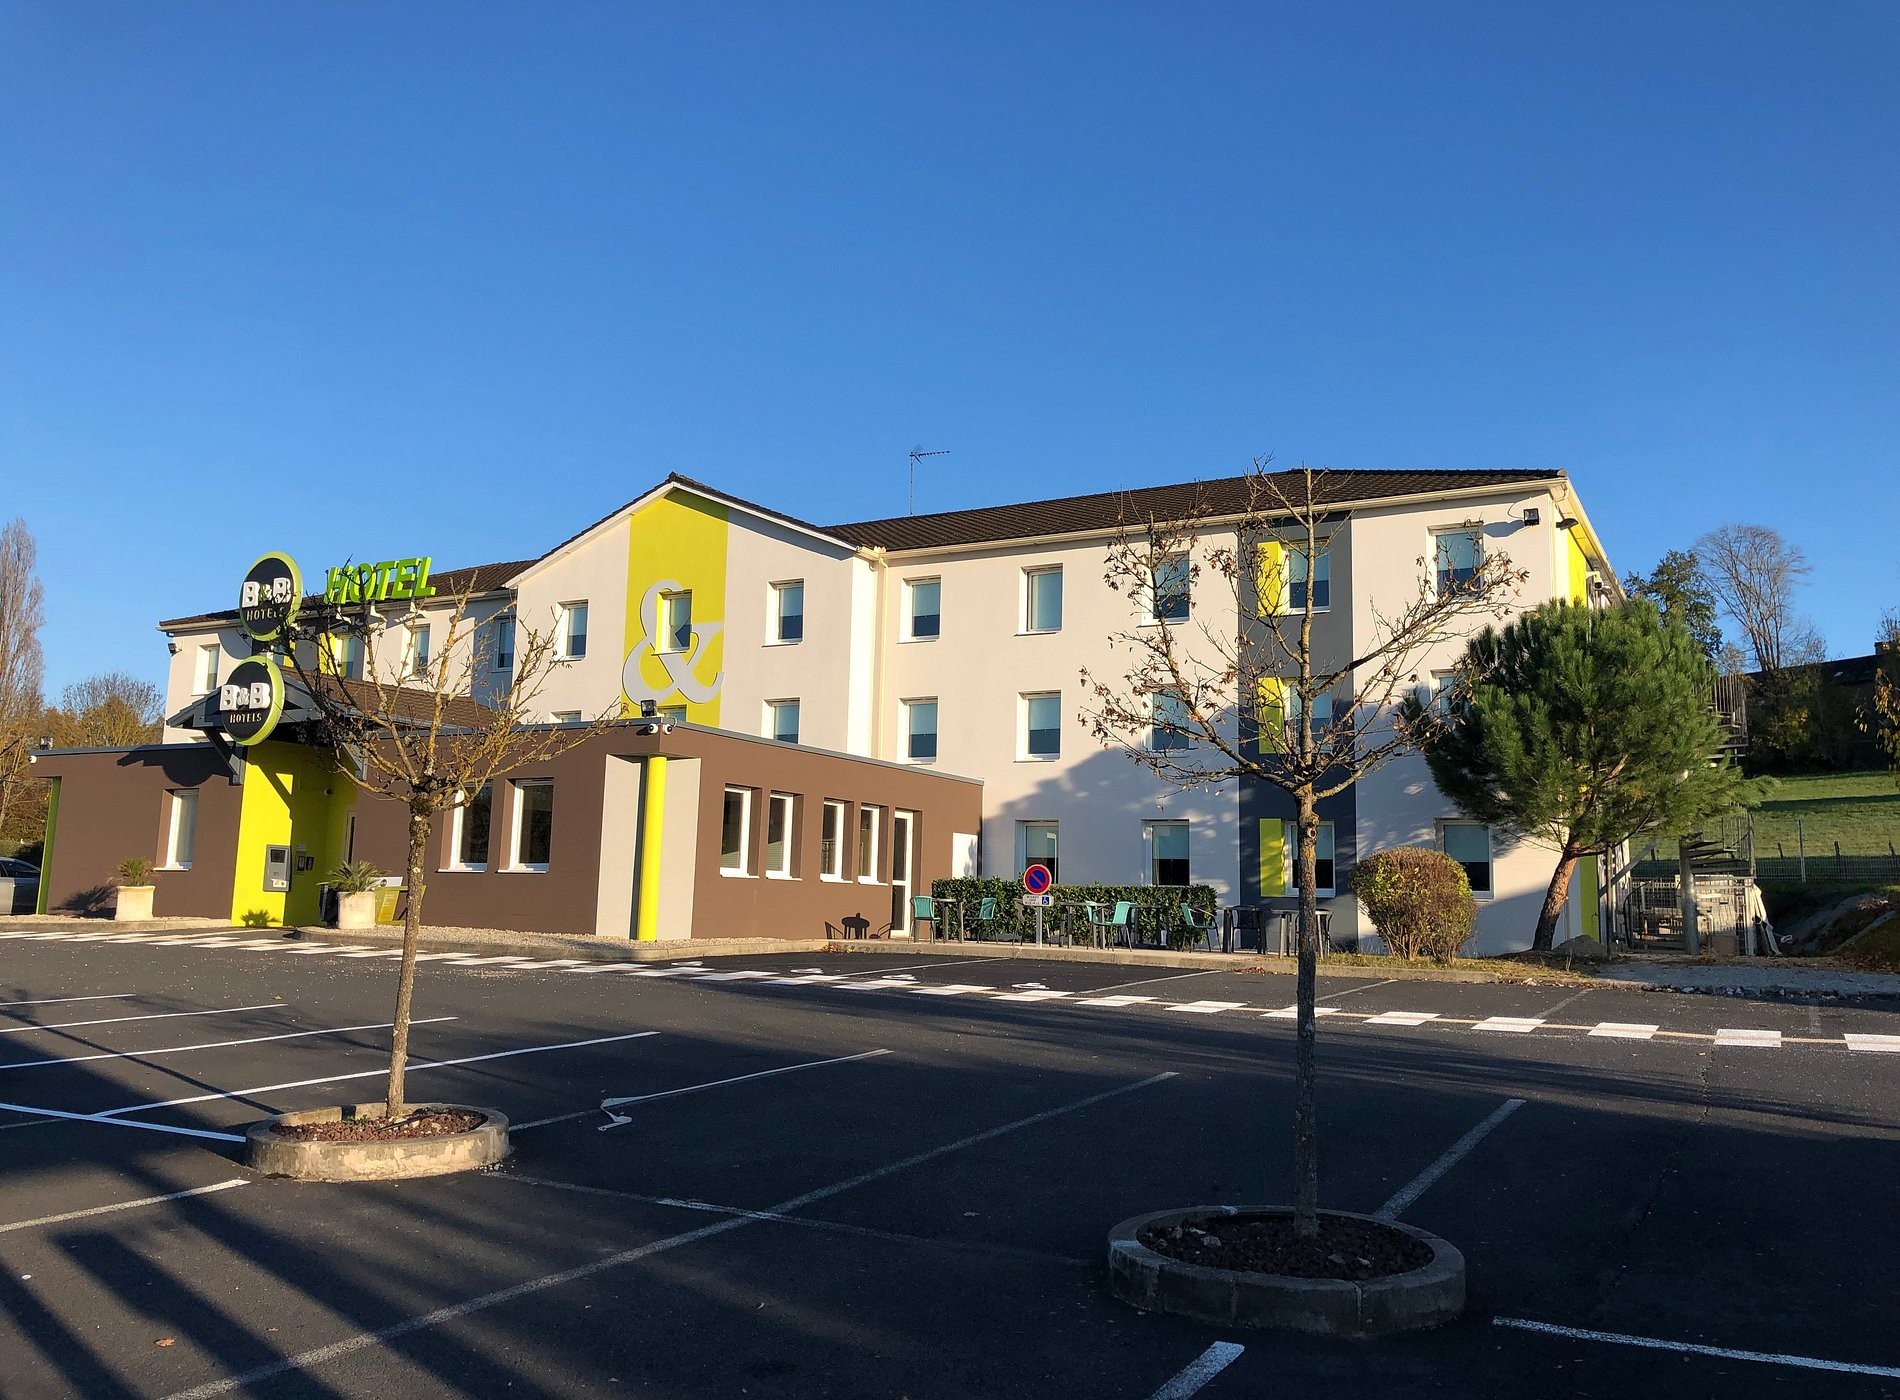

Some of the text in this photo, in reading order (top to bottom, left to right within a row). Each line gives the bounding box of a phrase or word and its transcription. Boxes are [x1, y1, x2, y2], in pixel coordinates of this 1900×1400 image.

[242, 577, 291, 608] B&B
[324, 556, 436, 604] HOTEL
[220, 682, 271, 711] B&B
[230, 713, 262, 724] HOTELS
